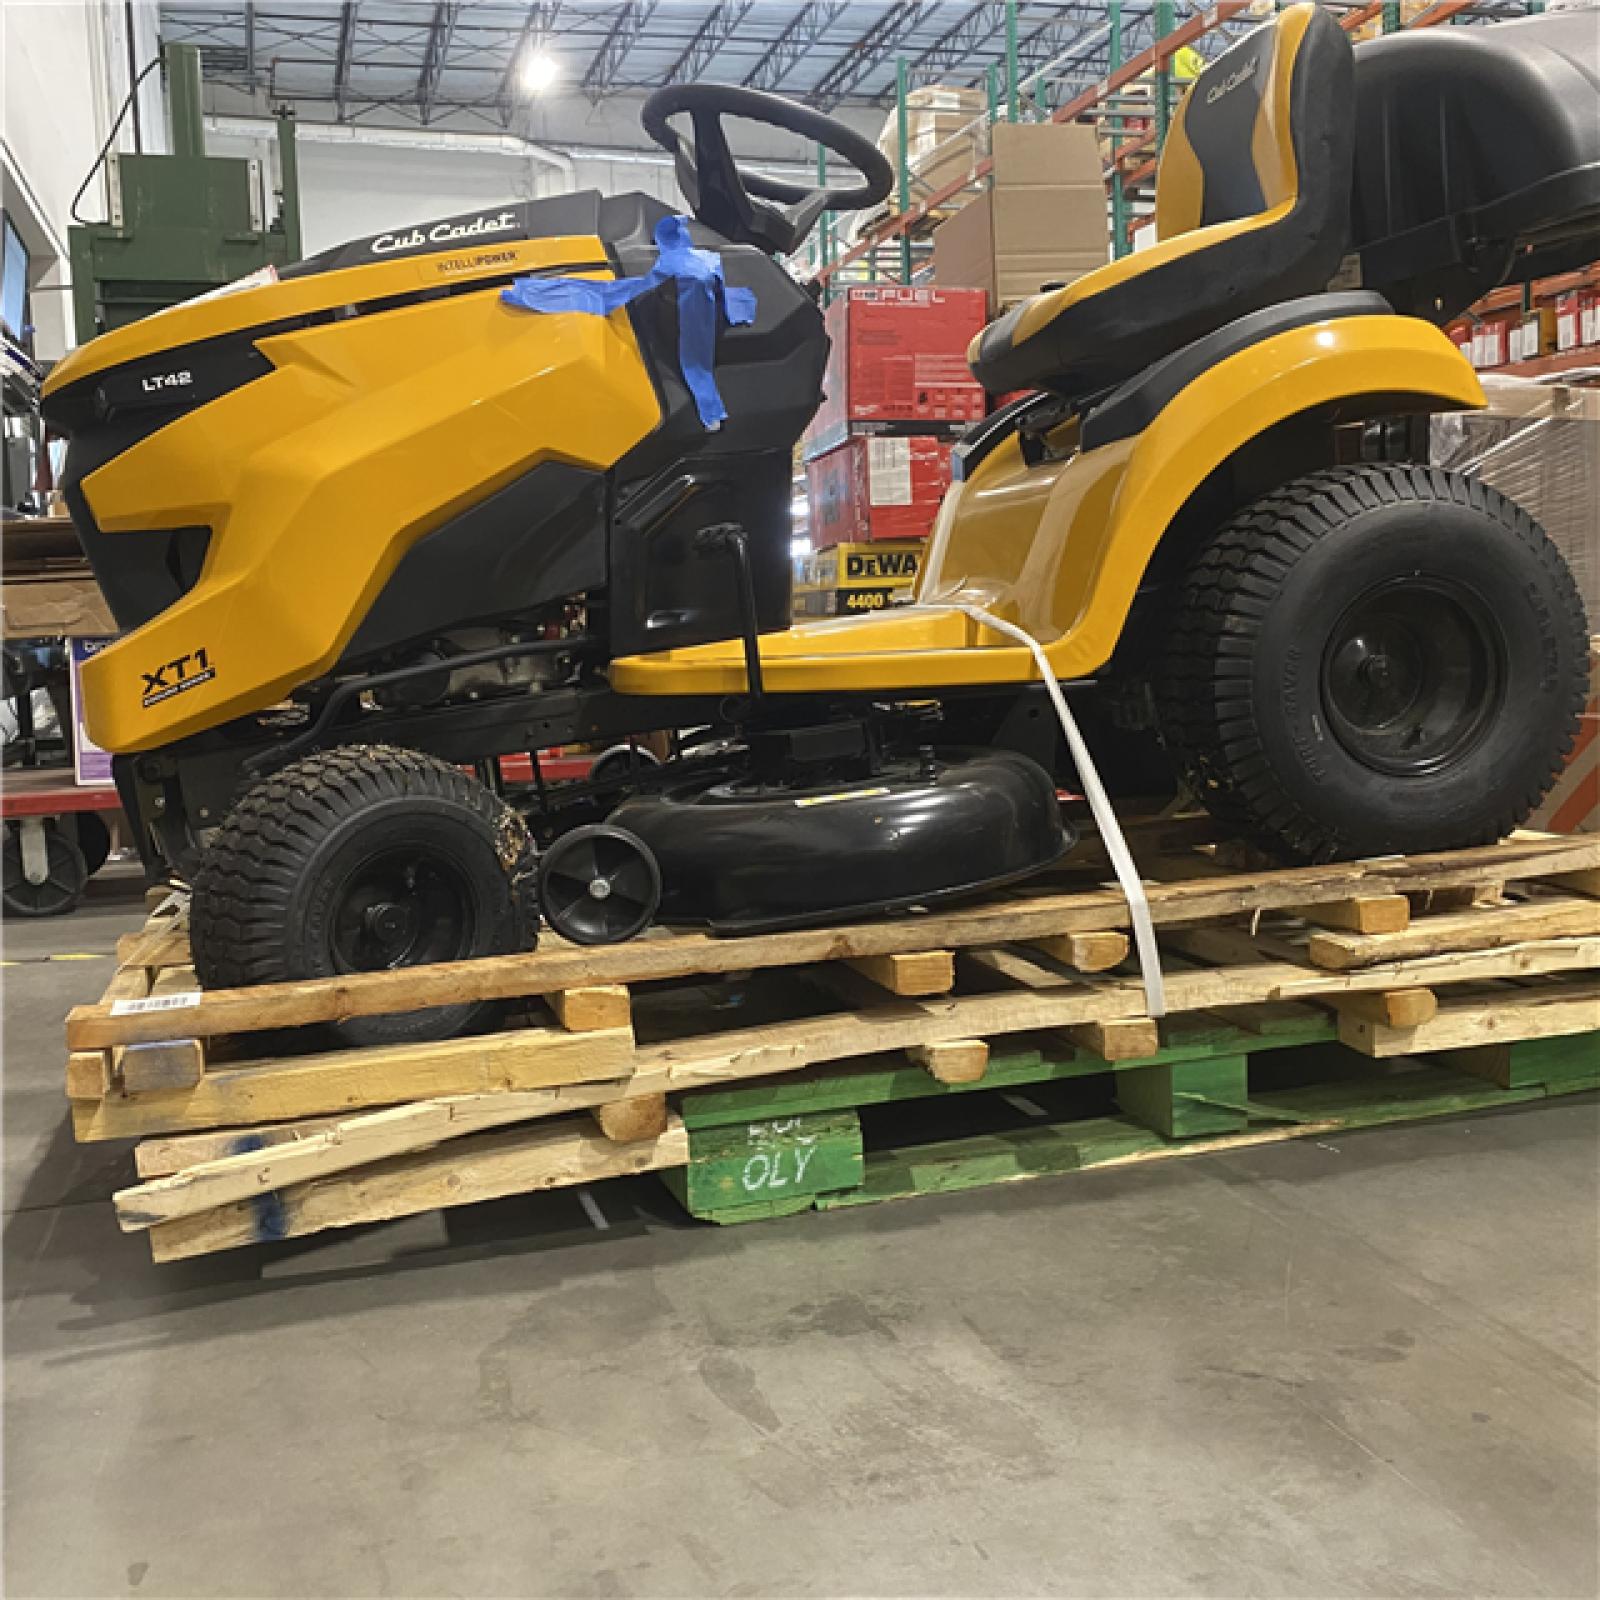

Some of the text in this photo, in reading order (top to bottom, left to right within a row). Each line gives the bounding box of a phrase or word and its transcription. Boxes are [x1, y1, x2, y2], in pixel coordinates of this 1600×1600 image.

[371, 212, 517, 253] Cub Cadet
[142, 370, 193, 391] LT42
[847, 554, 917, 577] DEWA
[847, 593, 884, 609] 4400
[141, 648, 208, 695] XT1
[742, 1145, 818, 1191] OLY
